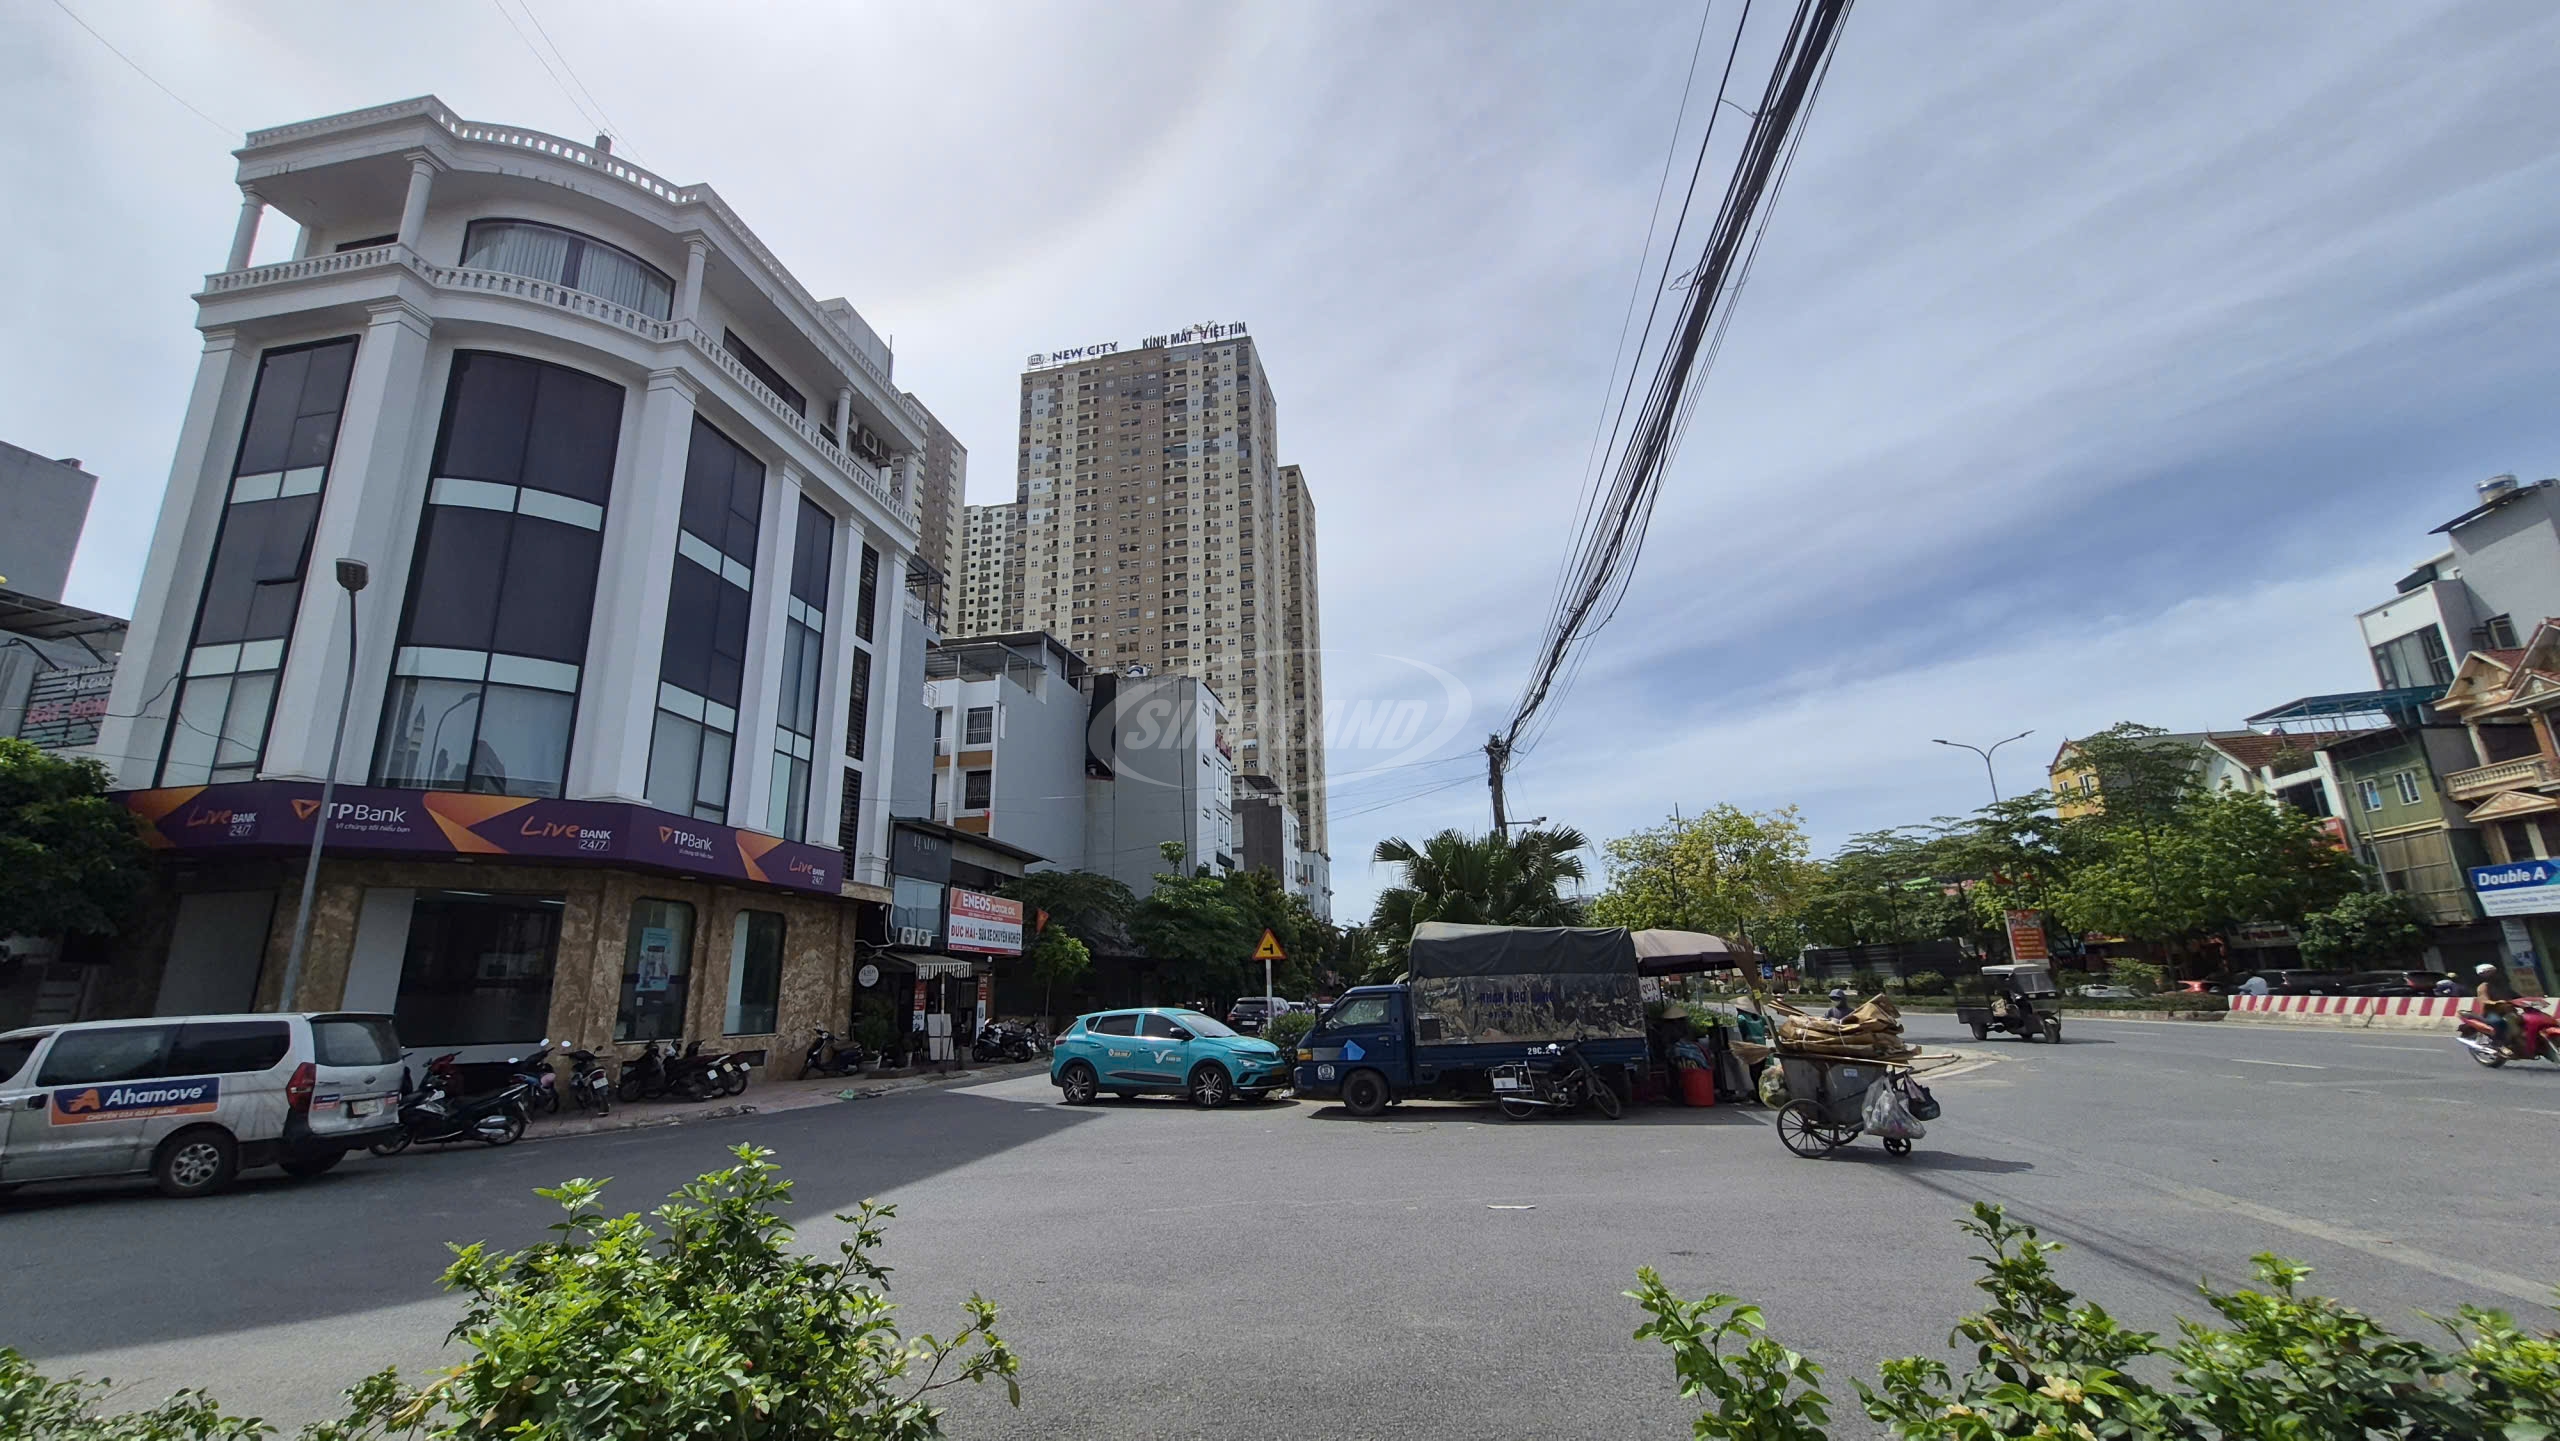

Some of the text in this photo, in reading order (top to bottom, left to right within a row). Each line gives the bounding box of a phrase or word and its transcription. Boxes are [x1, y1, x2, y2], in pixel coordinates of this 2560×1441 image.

[1142, 335, 1167, 349] KÍNH
[1228, 321, 1246, 335] TÍN
[1052, 347, 1085, 362] NEW
[1087, 341, 1119, 355] CITY
[186, 805, 257, 827] Live BANK
[326, 802, 405, 823] TPBank
[229, 824, 252, 836] 24/7
[520, 815, 611, 840] Live BANK
[580, 840, 607, 850] 24/7
[674, 829, 713, 852] TPBank
[789, 855, 825, 877] Live BANK
[2478, 866, 2547, 886] Double A
[962, 893, 991, 912] ENEOS
[105, 1086, 203, 1107] Ahamove
